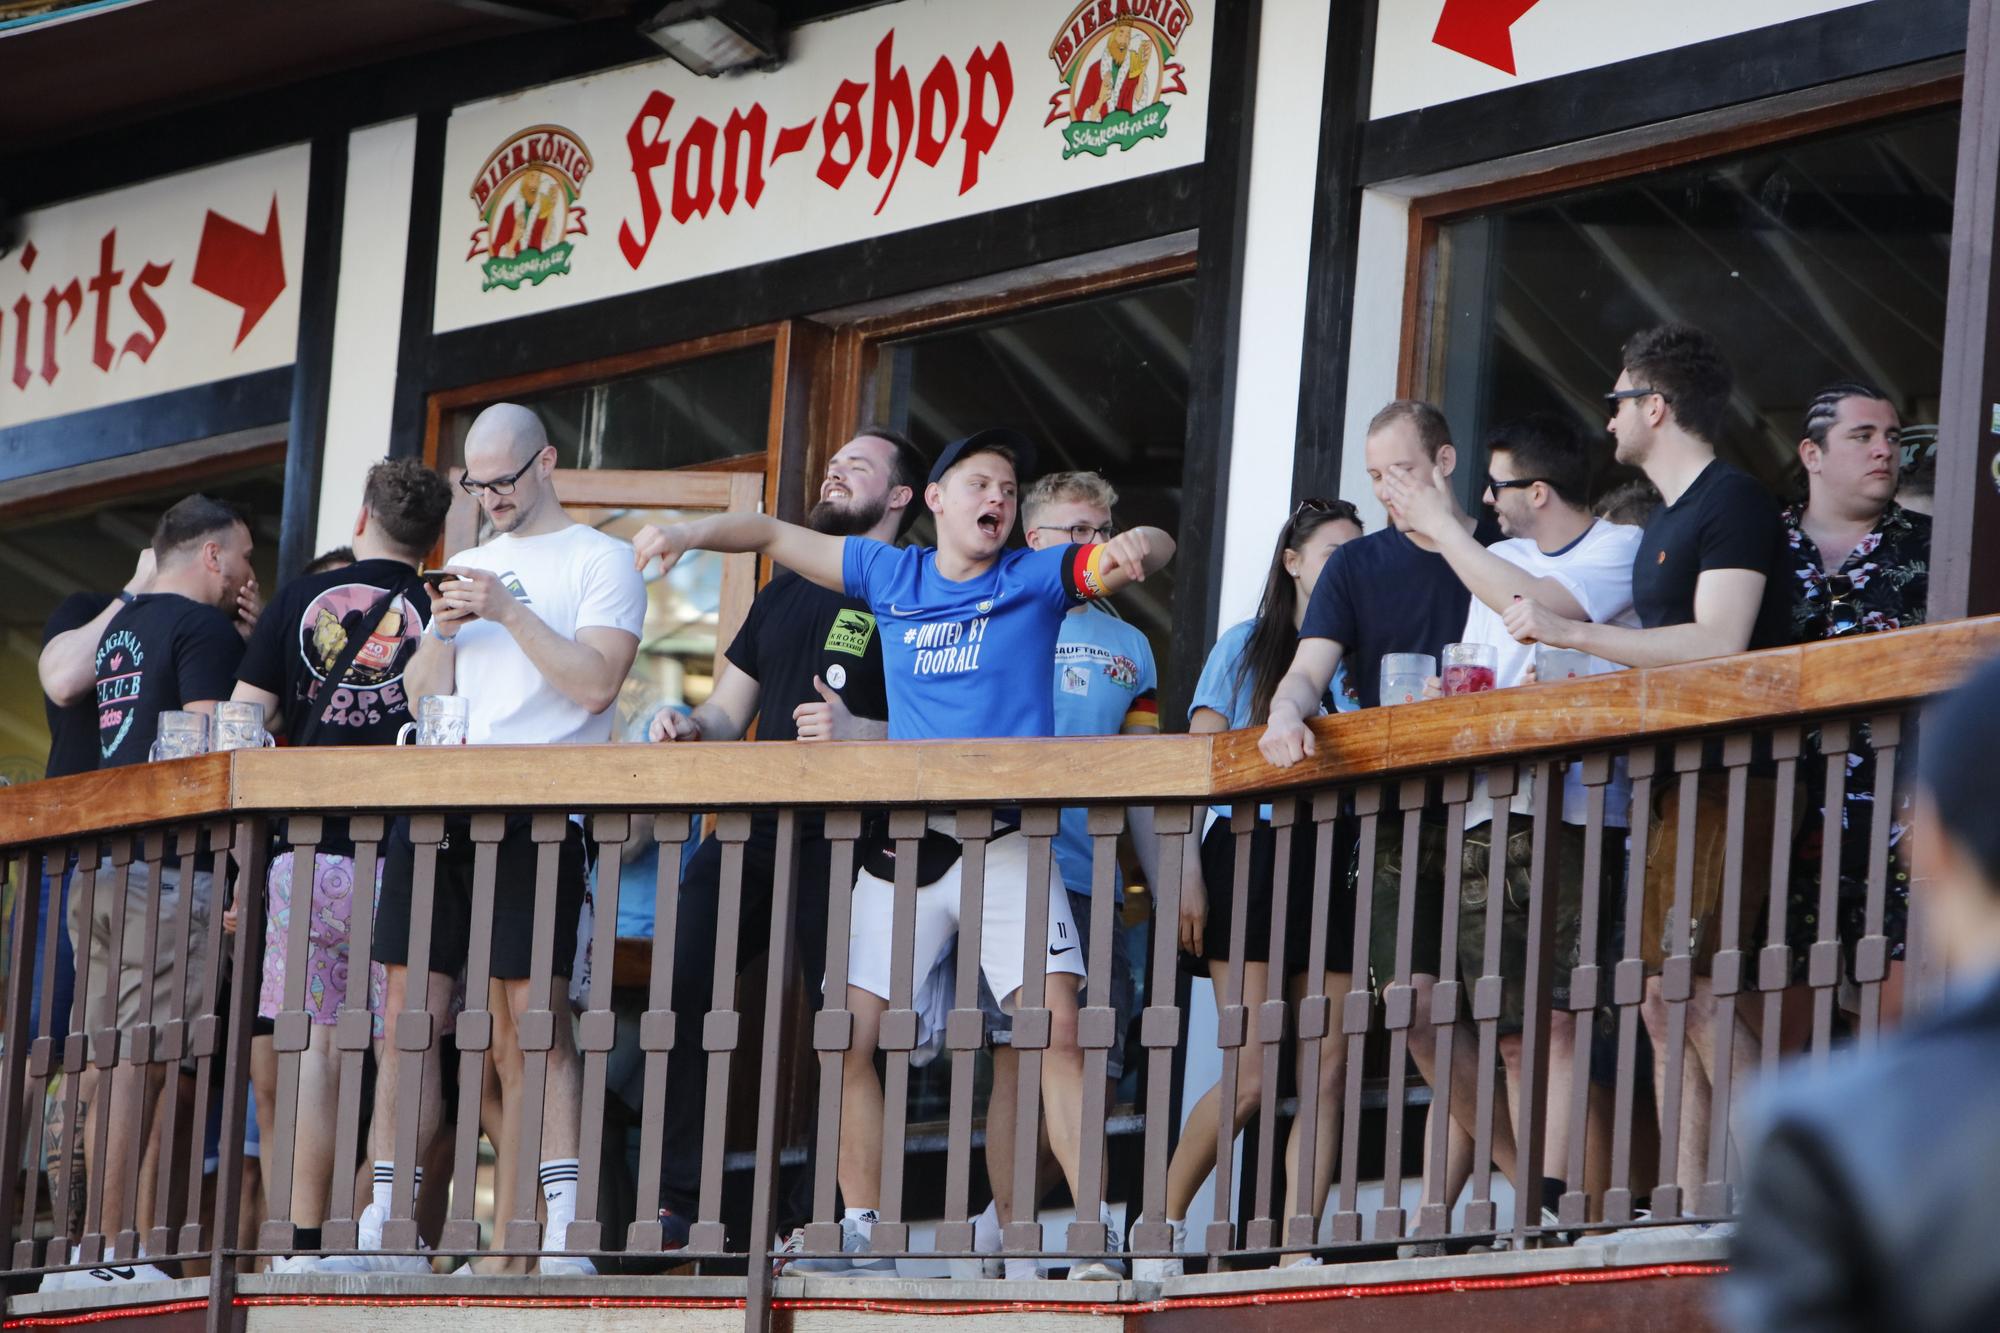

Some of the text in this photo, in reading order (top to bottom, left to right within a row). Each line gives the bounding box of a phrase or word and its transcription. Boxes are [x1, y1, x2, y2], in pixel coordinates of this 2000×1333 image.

[0, 226, 174, 391] irts
[831, 633, 864, 646] KROKO
[903, 617, 989, 649] #UNITED BY
[914, 644, 980, 675] FOOTBALL
